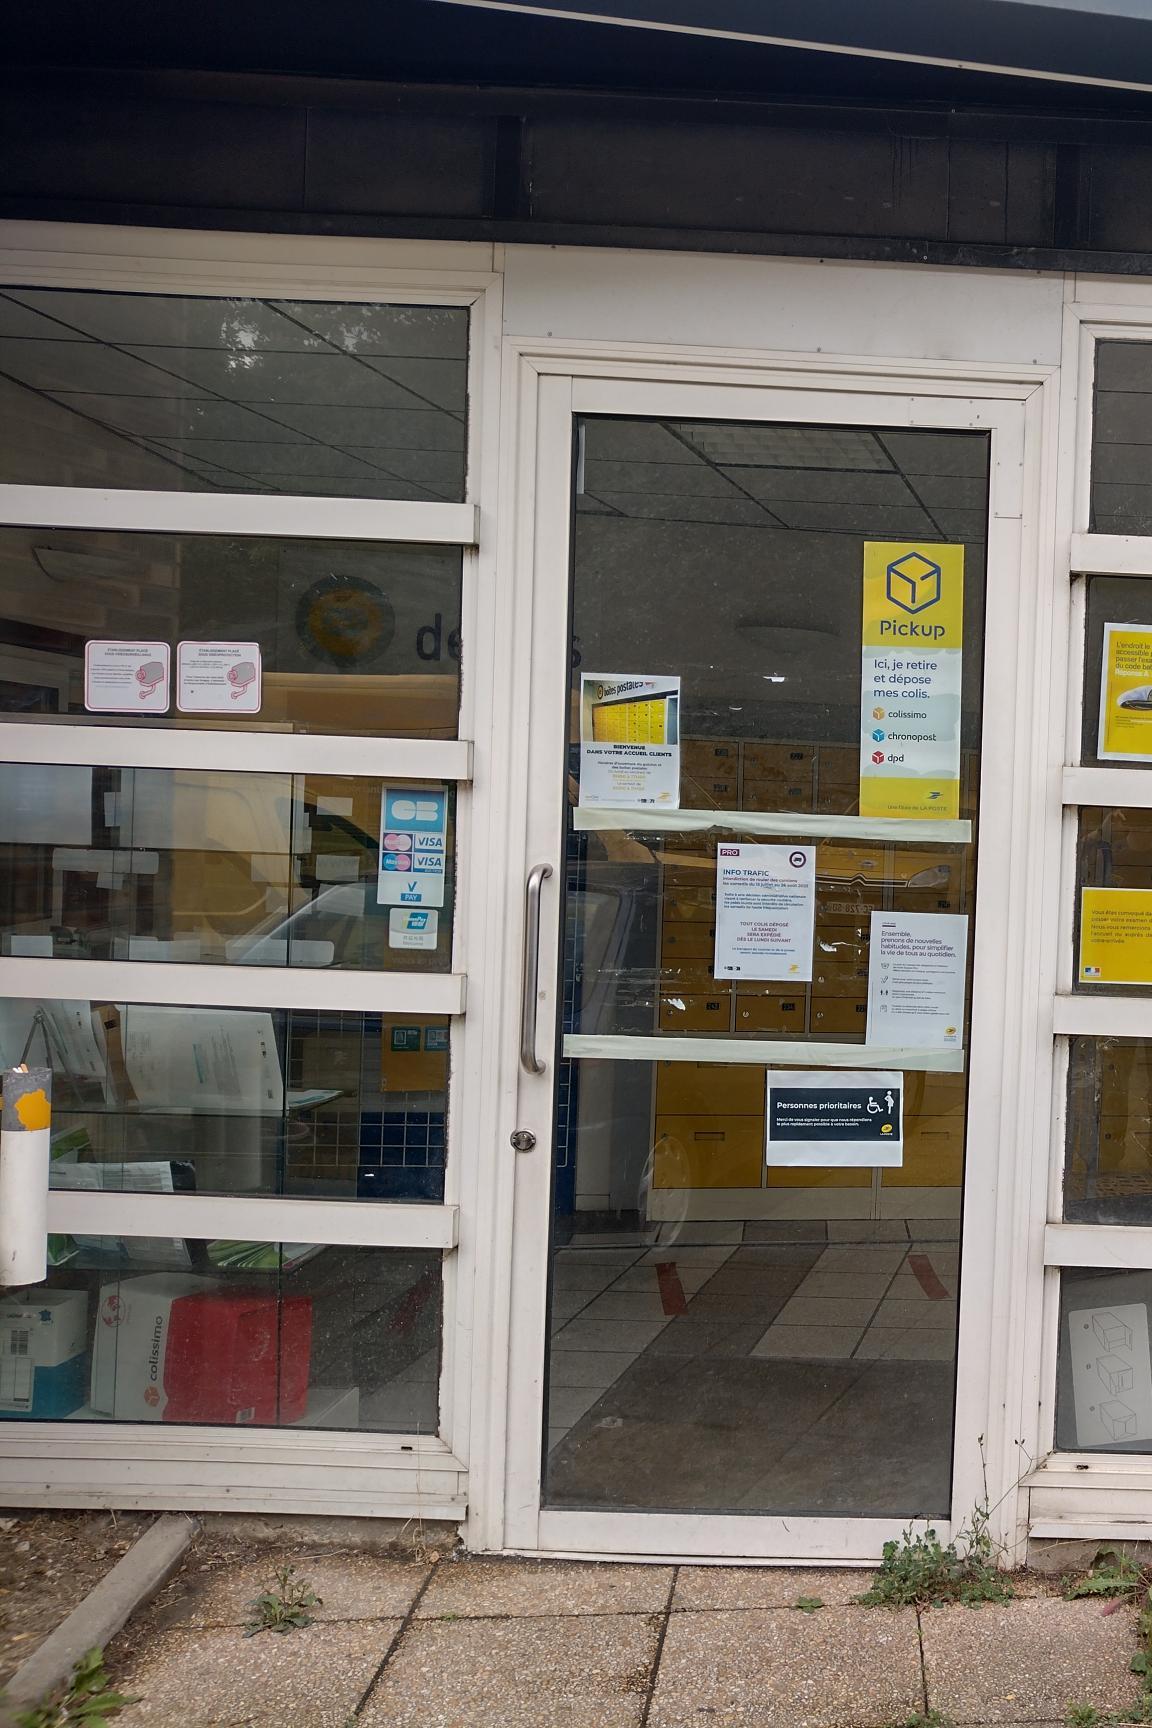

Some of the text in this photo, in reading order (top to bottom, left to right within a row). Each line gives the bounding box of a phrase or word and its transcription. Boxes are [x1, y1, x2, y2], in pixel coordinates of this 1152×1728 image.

[880, 620, 946, 640] Pickup
[874, 659, 938, 671] Ici, je retire
[874, 674, 932, 686] et dépose
[873, 688, 930, 699] mes colis.
[888, 710, 927, 719] colissimo
[888, 732, 937, 742] chronopost
[887, 754, 904, 764] dpd
[391, 800, 438, 821] CB
[418, 837, 442, 847] VISA
[417, 857, 442, 867] VISA
[820, 1102, 862, 1110] prioritaires
[149, 1315, 162, 1382] colissimo
